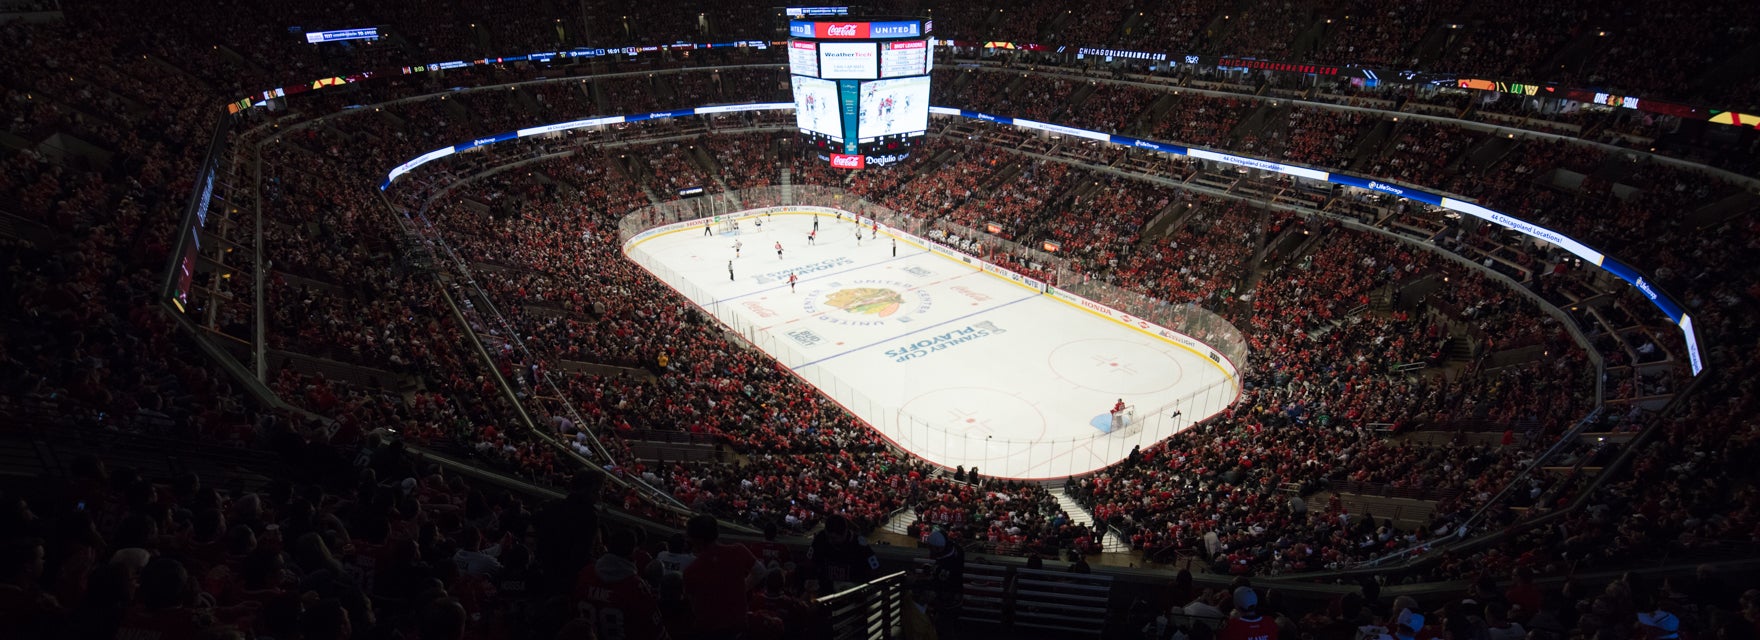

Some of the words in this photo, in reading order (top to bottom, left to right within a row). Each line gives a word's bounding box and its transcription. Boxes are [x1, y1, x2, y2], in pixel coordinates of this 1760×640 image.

[827, 24, 857, 36] Coca-Cola
[875, 24, 909, 34] UNITED
[1594, 92, 1609, 105] ONE
[1623, 96, 1639, 109] GOAL
[833, 155, 860, 167] Coca-Cola
[1375, 182, 1403, 196] LifeStorage
[1490, 213, 1499, 221] 44
[1499, 216, 1532, 233] Chicagoland
[1532, 228, 1563, 243] Locations!
[984, 263, 1008, 277] DISCOVER
[1081, 299, 1112, 316] HONDA
[884, 326, 975, 358] PLAYOFFS
[931, 329, 990, 353] STANLEY
[896, 349, 928, 363] CUP
